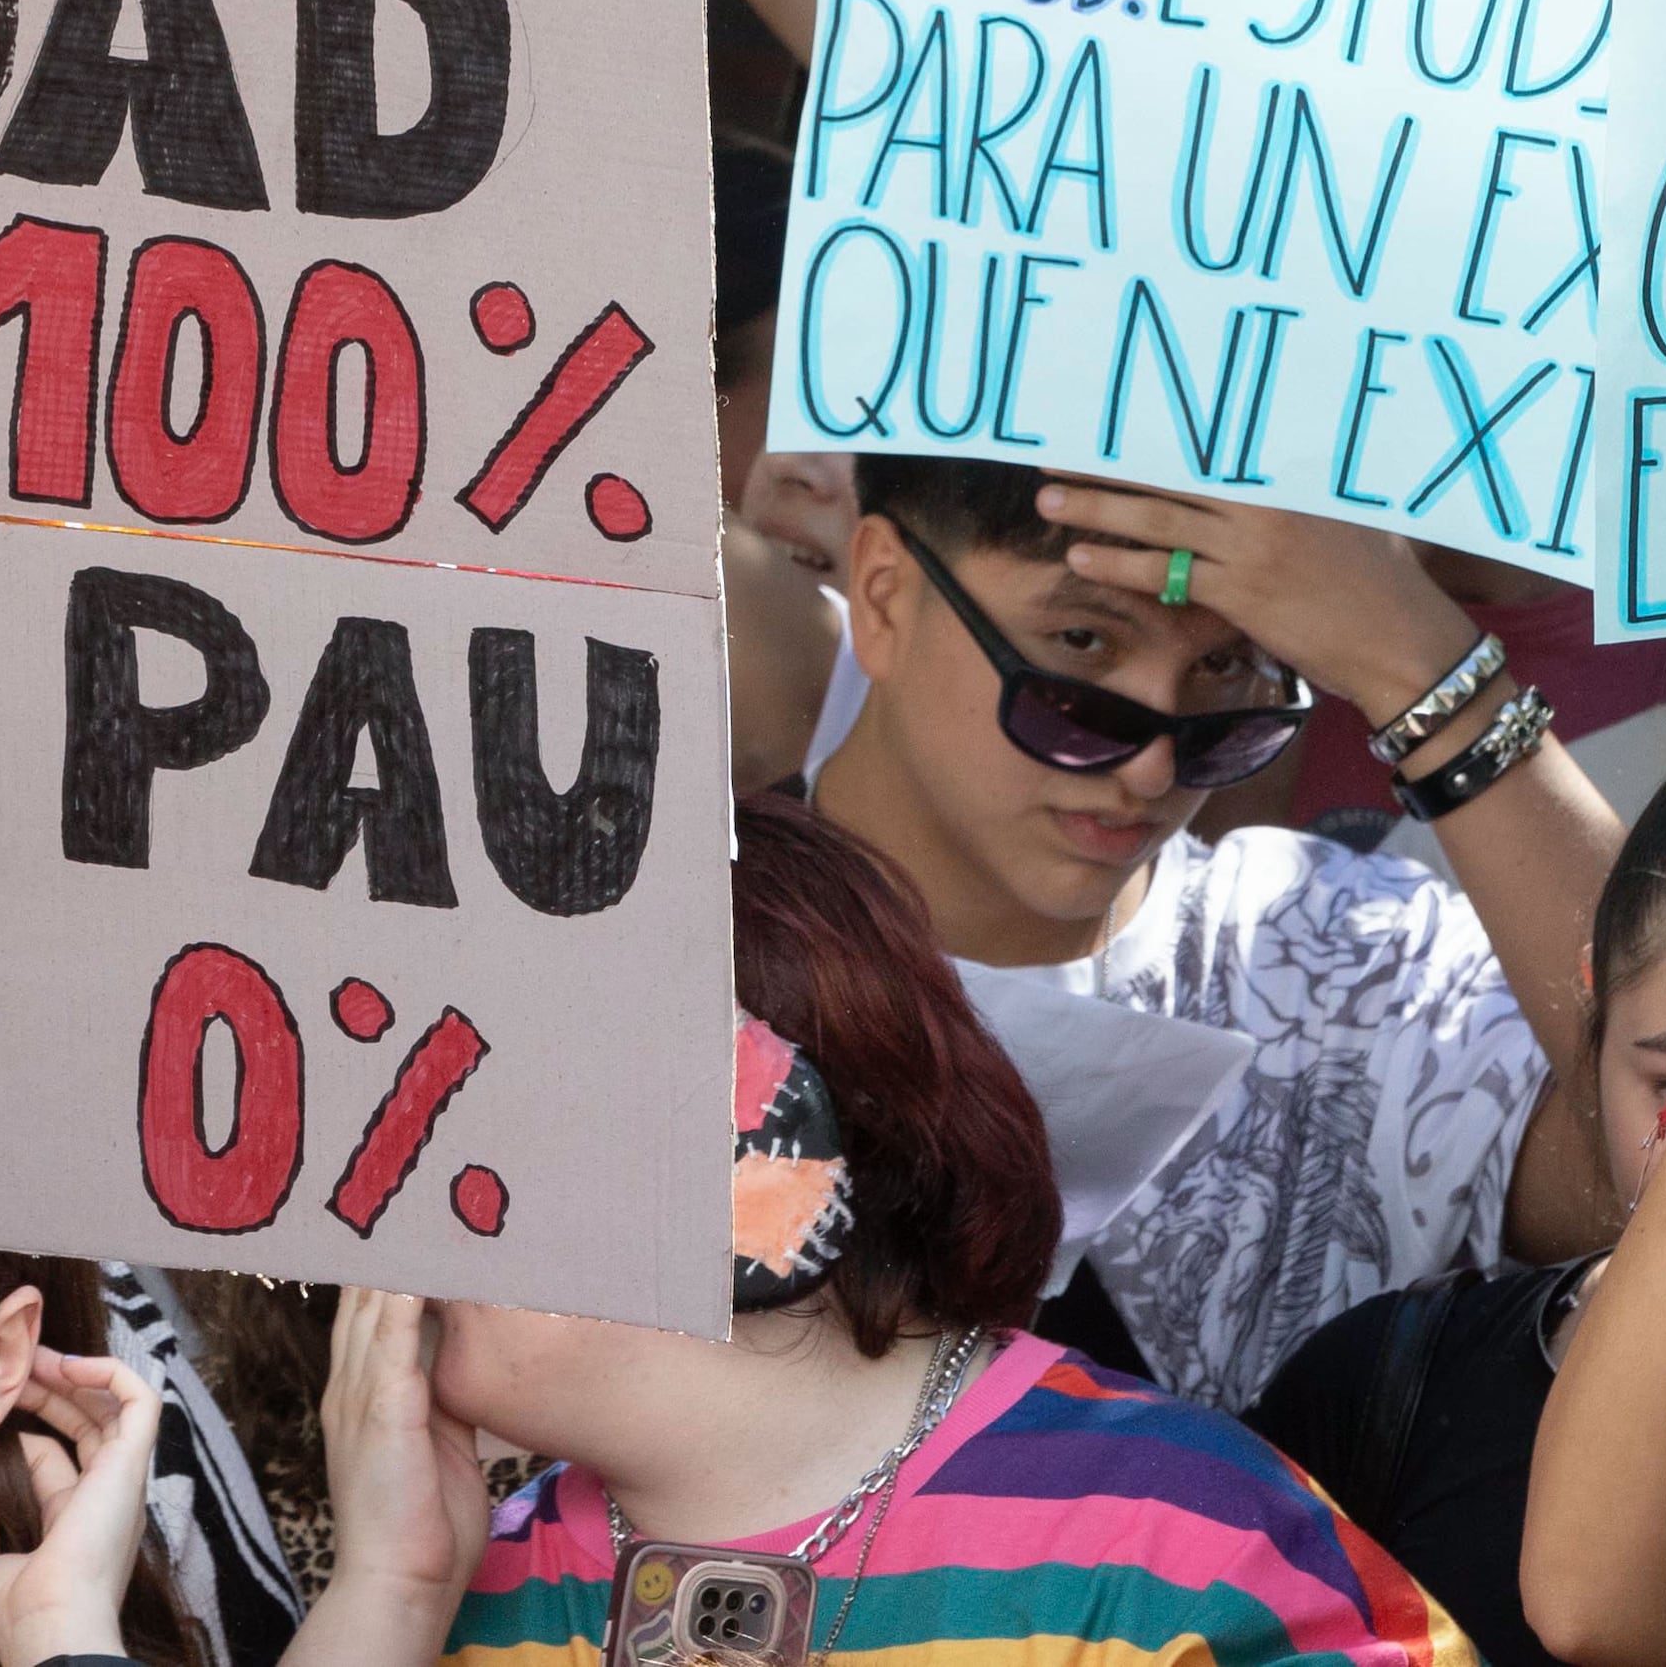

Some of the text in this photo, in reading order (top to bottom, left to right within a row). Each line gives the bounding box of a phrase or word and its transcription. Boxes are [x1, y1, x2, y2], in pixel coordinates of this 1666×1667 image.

[1178, 67, 1417, 300] UN
[799, 219, 1079, 448] QUE
[1102, 276, 1299, 487] NI
[60, 564, 661, 917] PAU
[137, 940, 510, 1236] 0%
